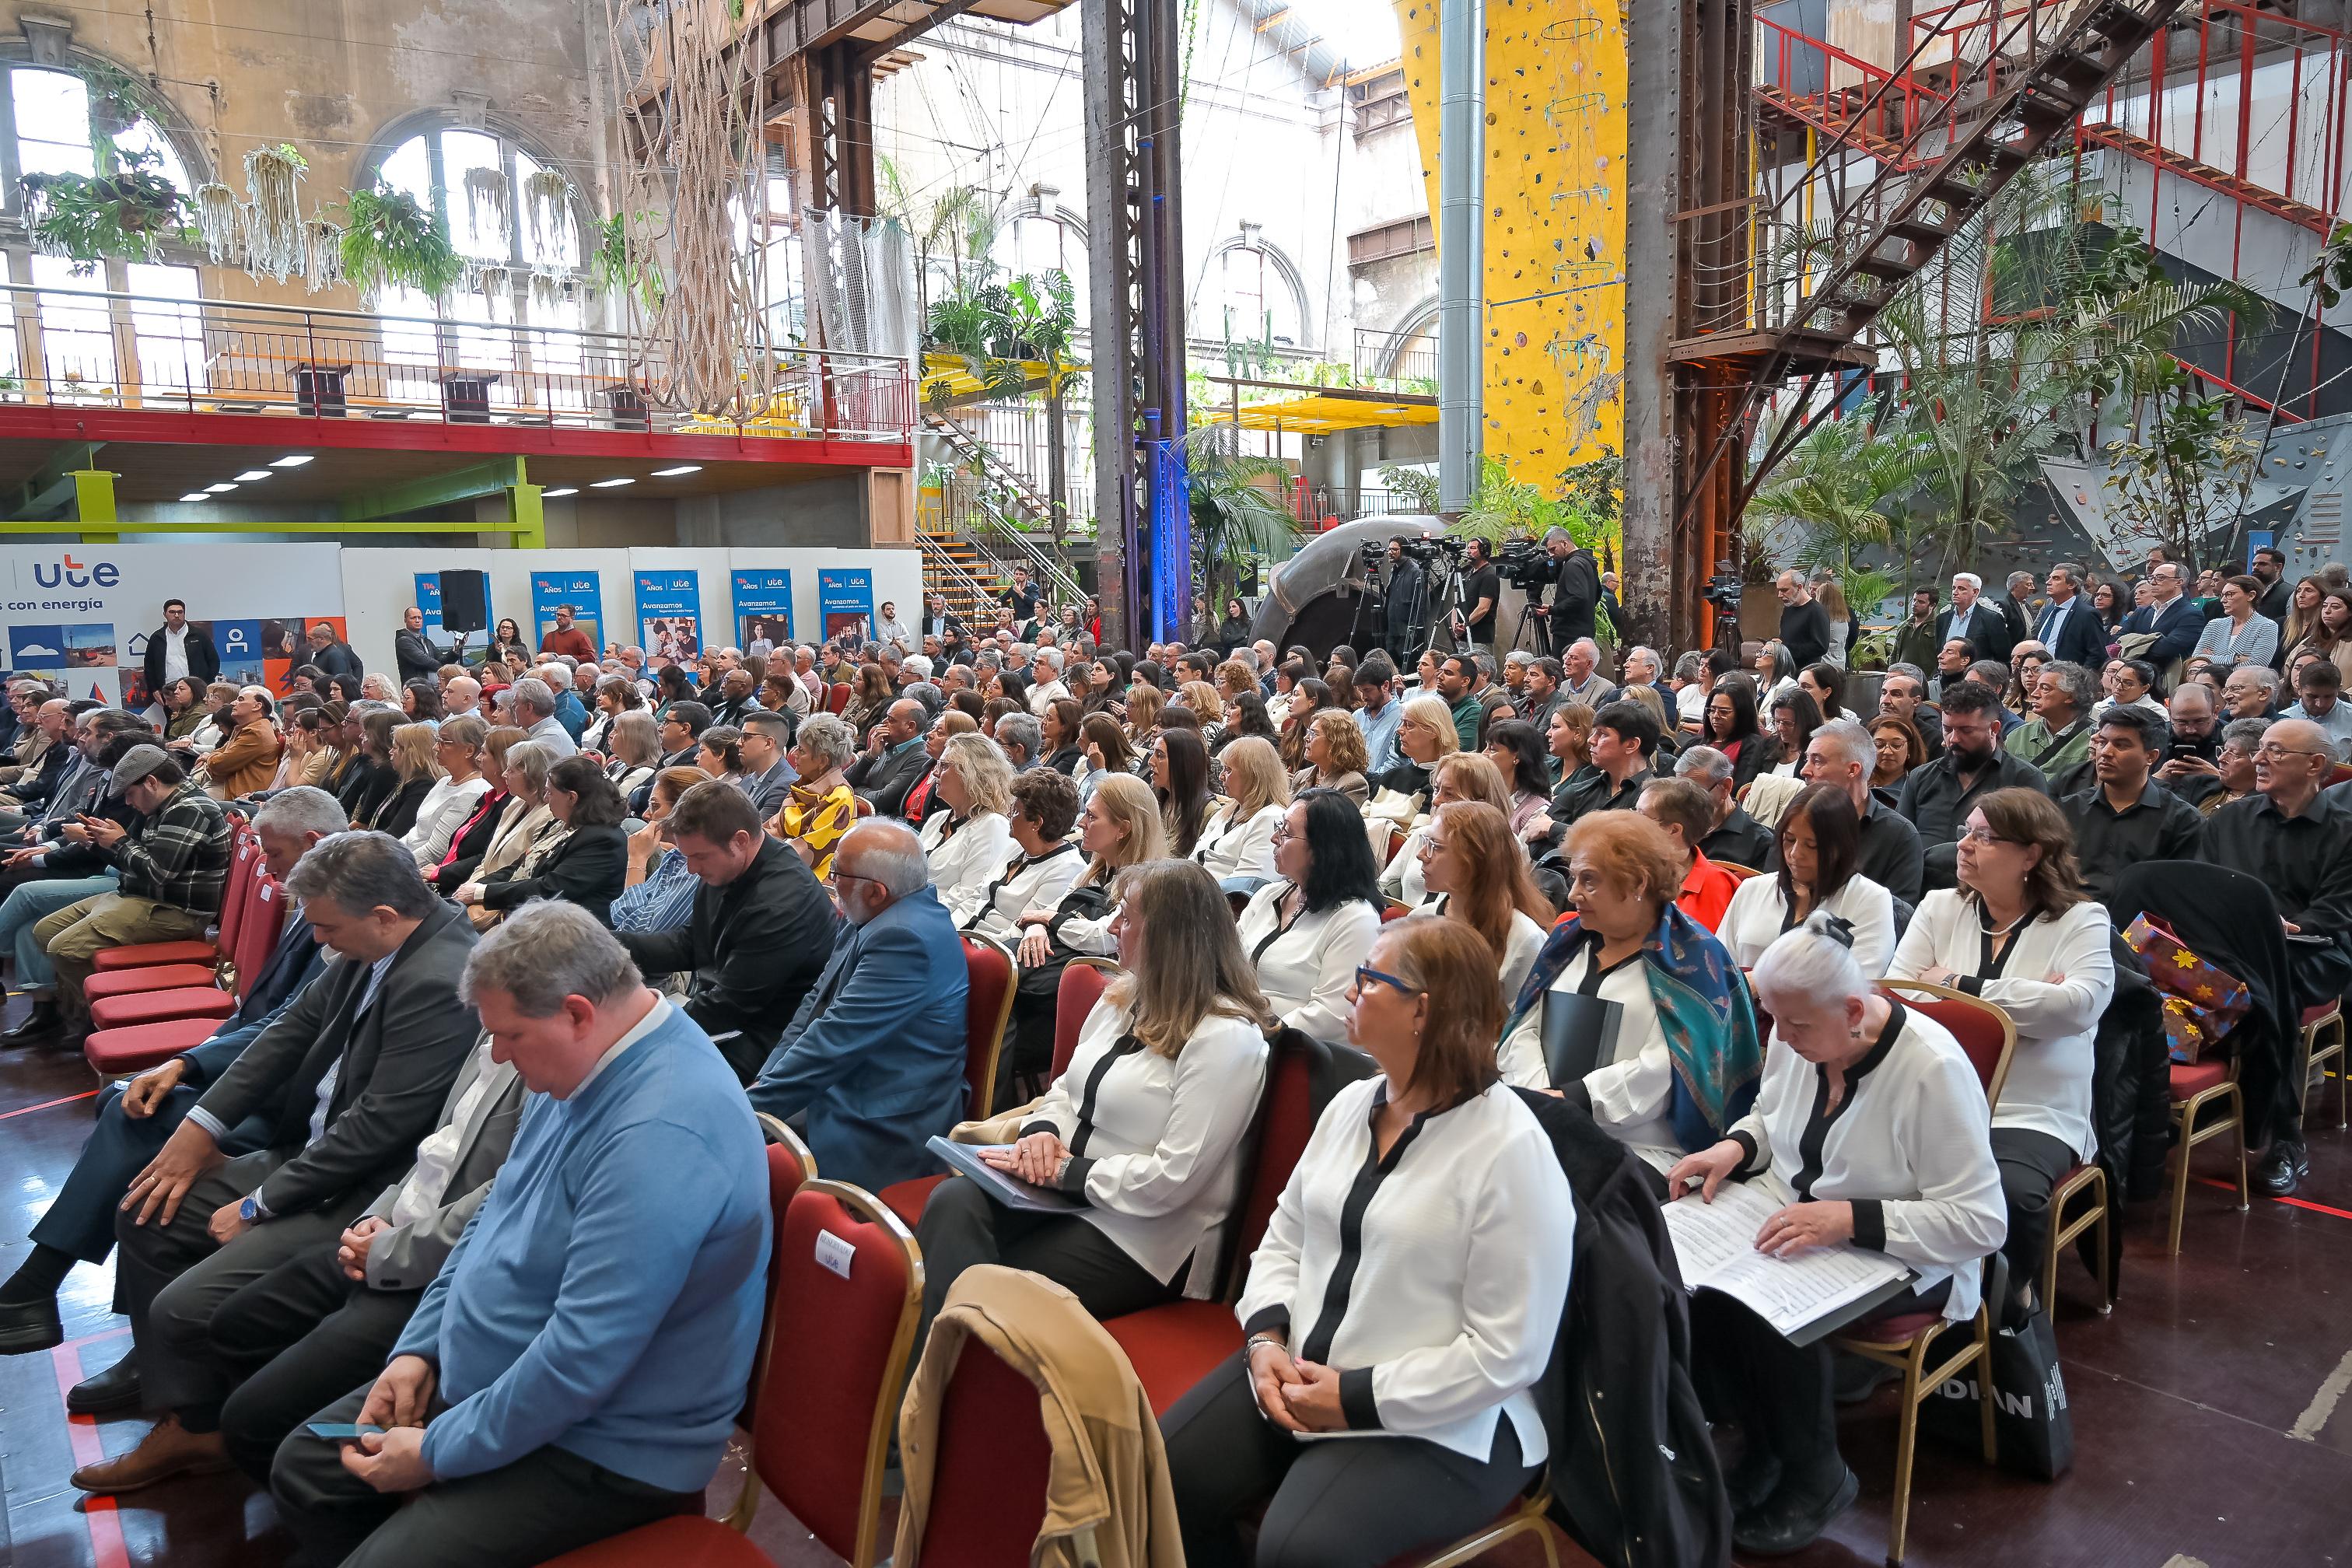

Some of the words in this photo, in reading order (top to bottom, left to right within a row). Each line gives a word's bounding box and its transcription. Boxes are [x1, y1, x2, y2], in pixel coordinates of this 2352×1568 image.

[33, 554, 120, 589] ute
[7, 601, 37, 611] con
[41, 597, 103, 612] energía
